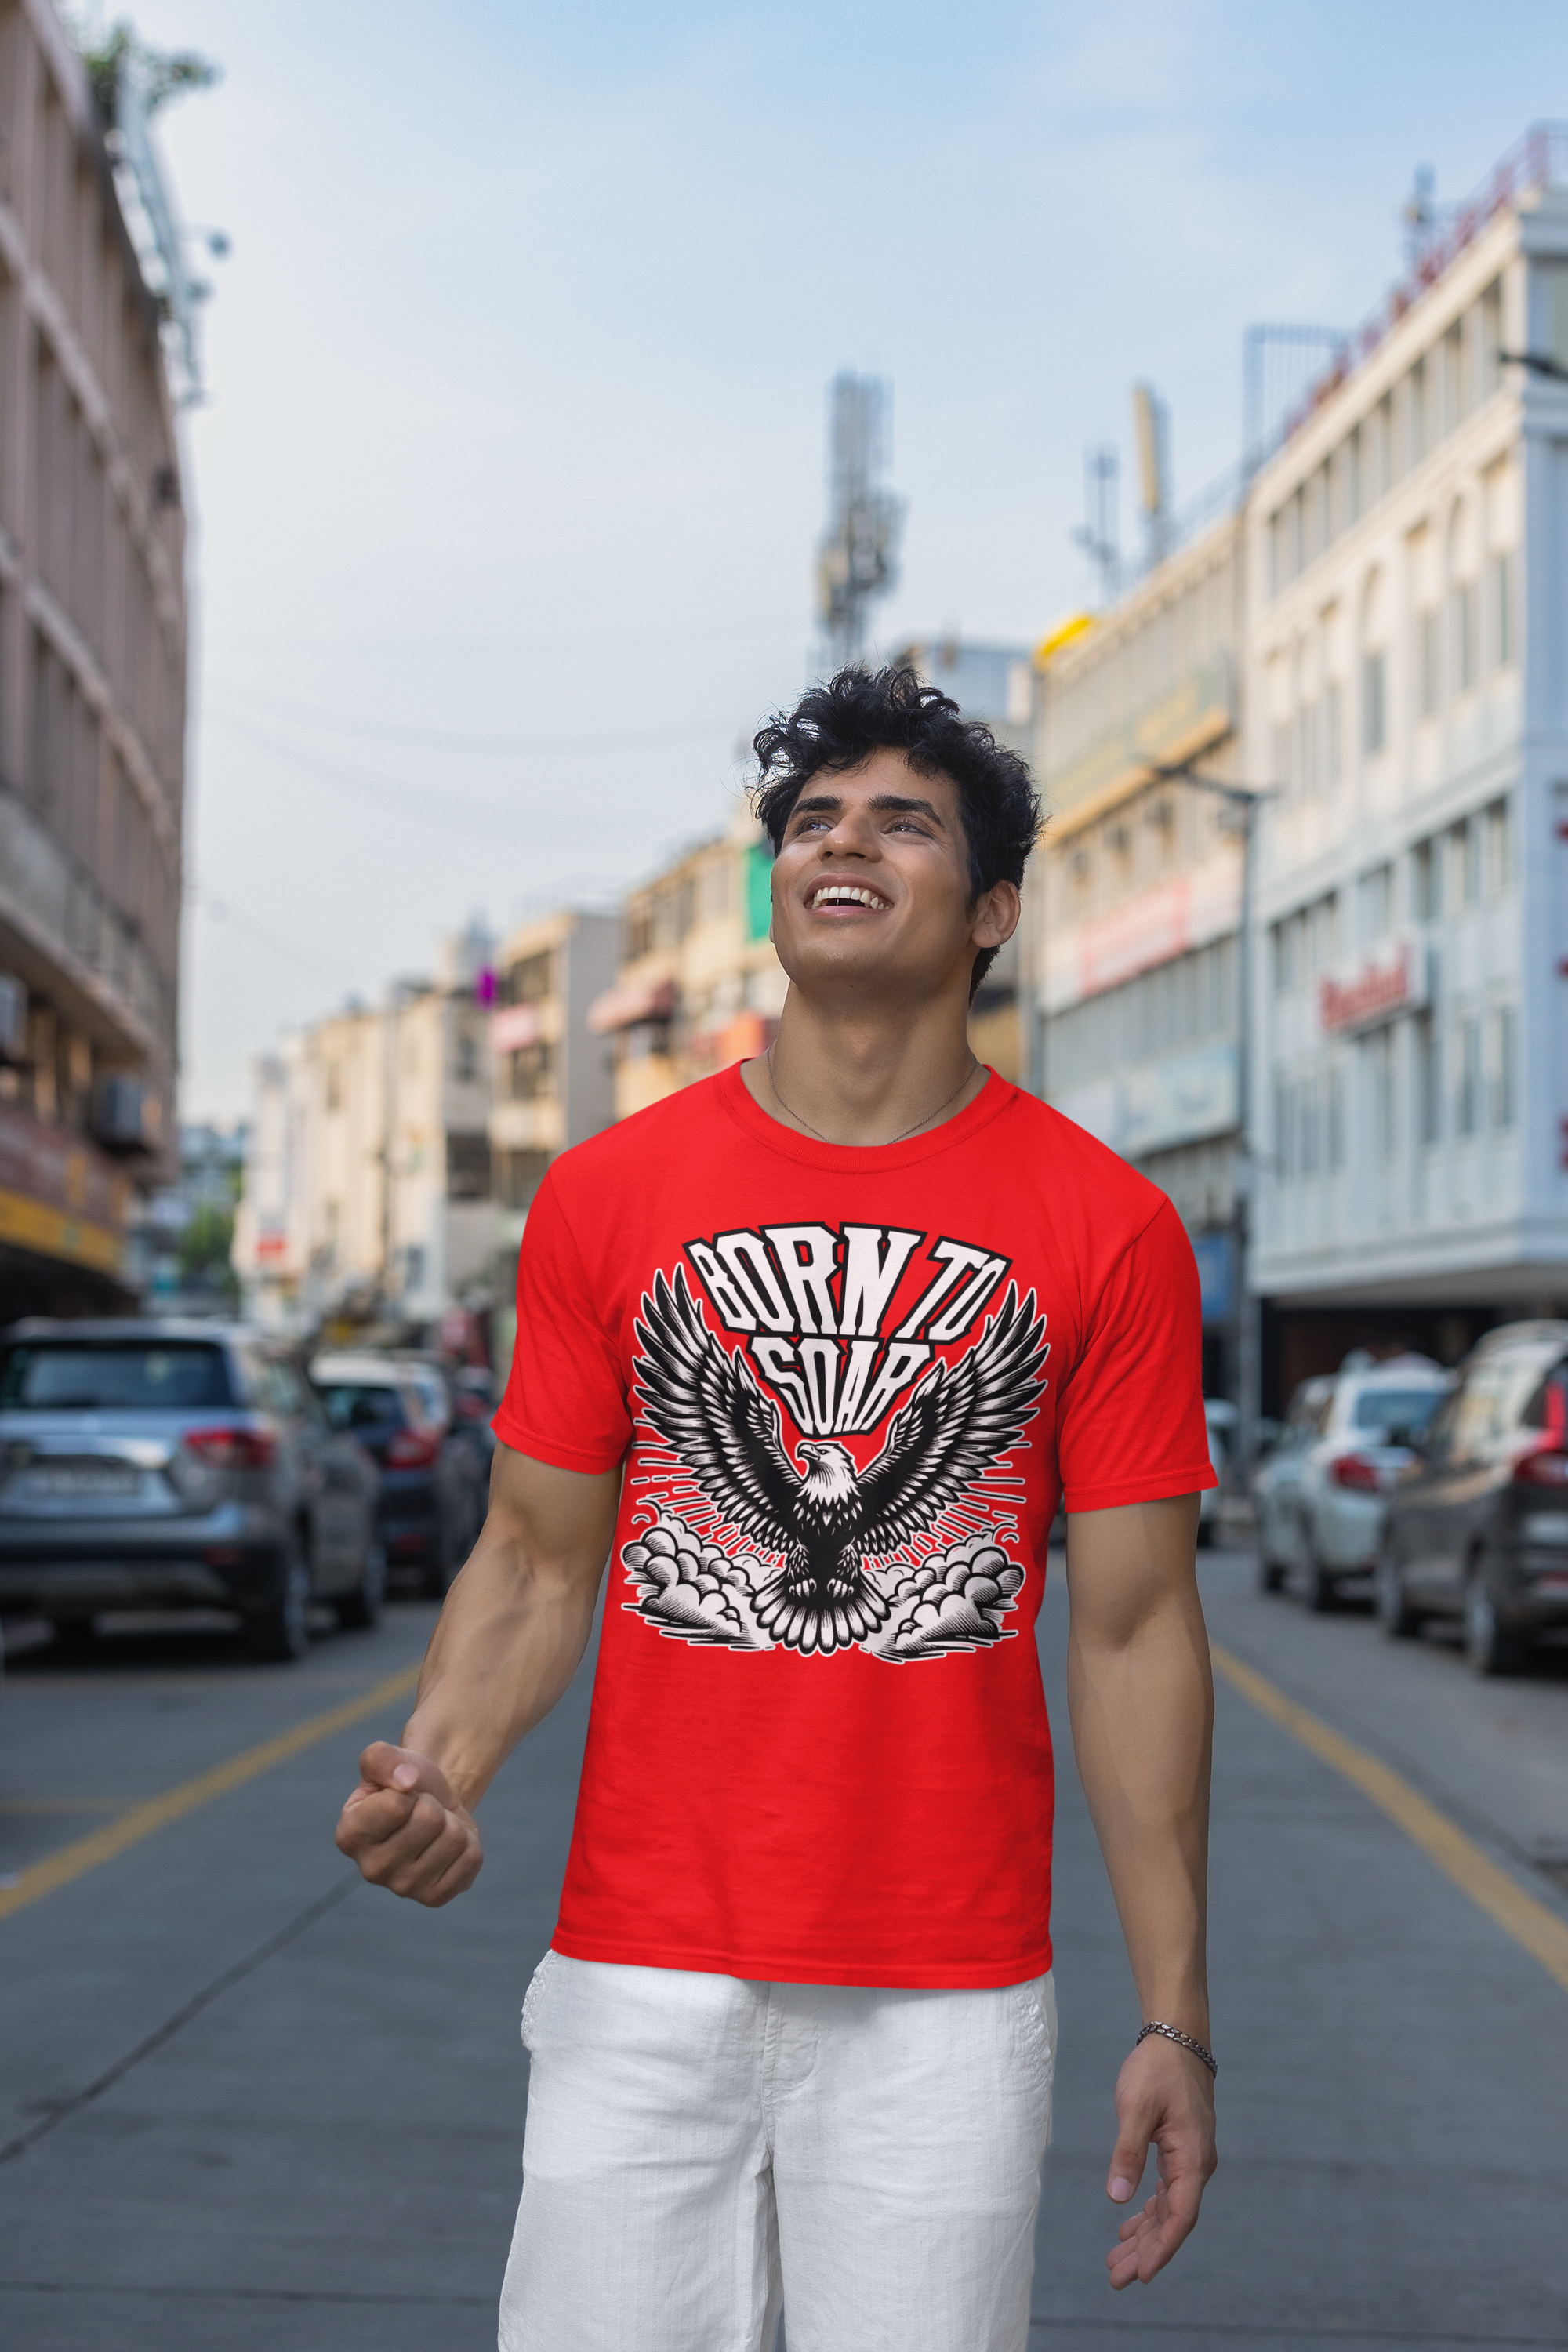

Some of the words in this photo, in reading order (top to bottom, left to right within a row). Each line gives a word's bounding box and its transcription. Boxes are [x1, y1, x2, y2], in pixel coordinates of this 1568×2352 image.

[686, 1224, 924, 1337] BORN
[894, 1238, 1010, 1342] TO
[748, 1335, 933, 1436] SOAR
